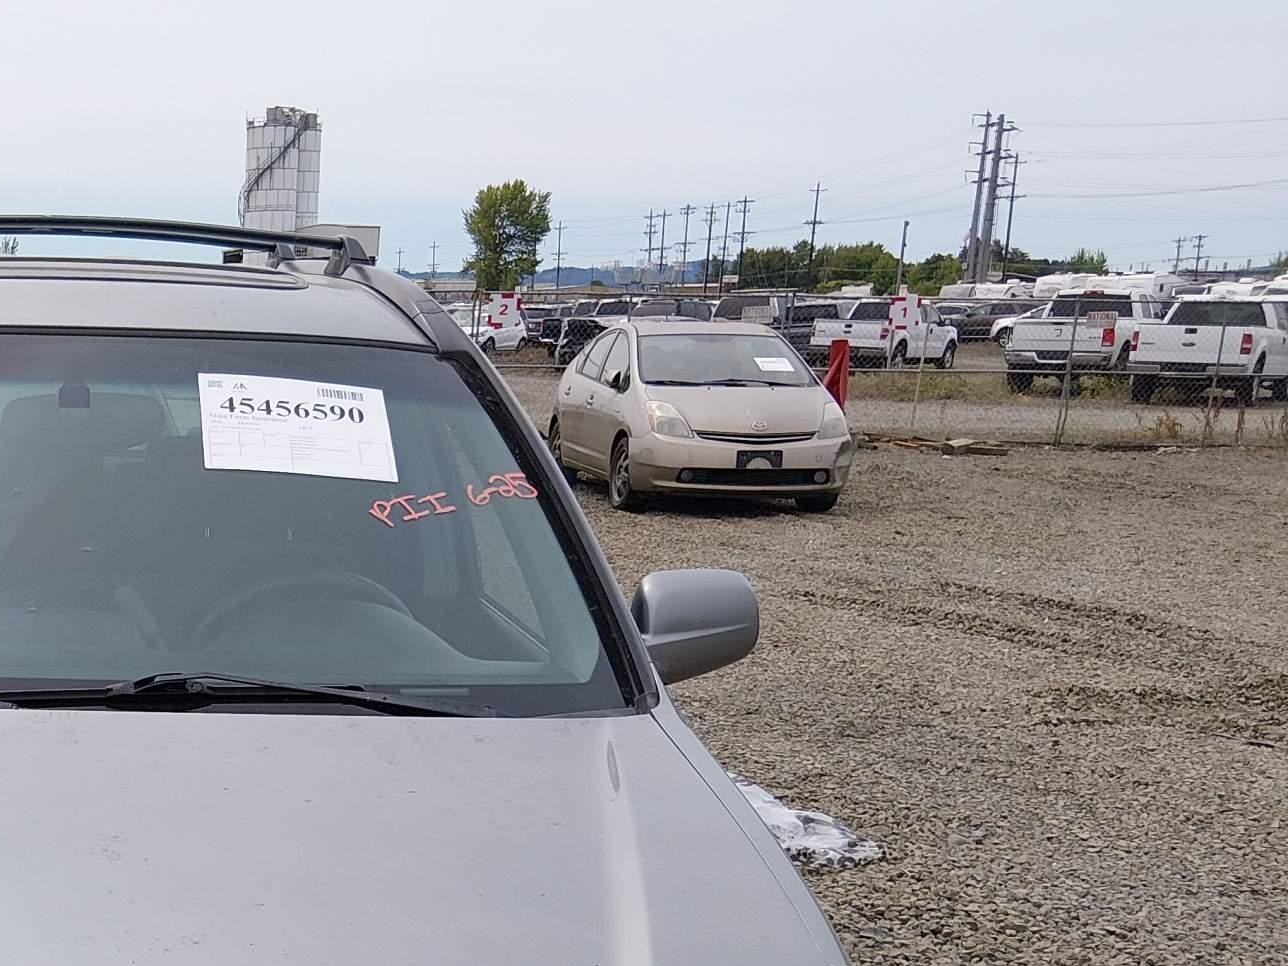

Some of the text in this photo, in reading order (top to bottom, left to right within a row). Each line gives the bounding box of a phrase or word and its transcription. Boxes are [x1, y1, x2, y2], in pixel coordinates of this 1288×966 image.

[498, 303, 509, 316] 2
[900, 306, 908, 318] 1
[219, 396, 366, 424] 45456590
